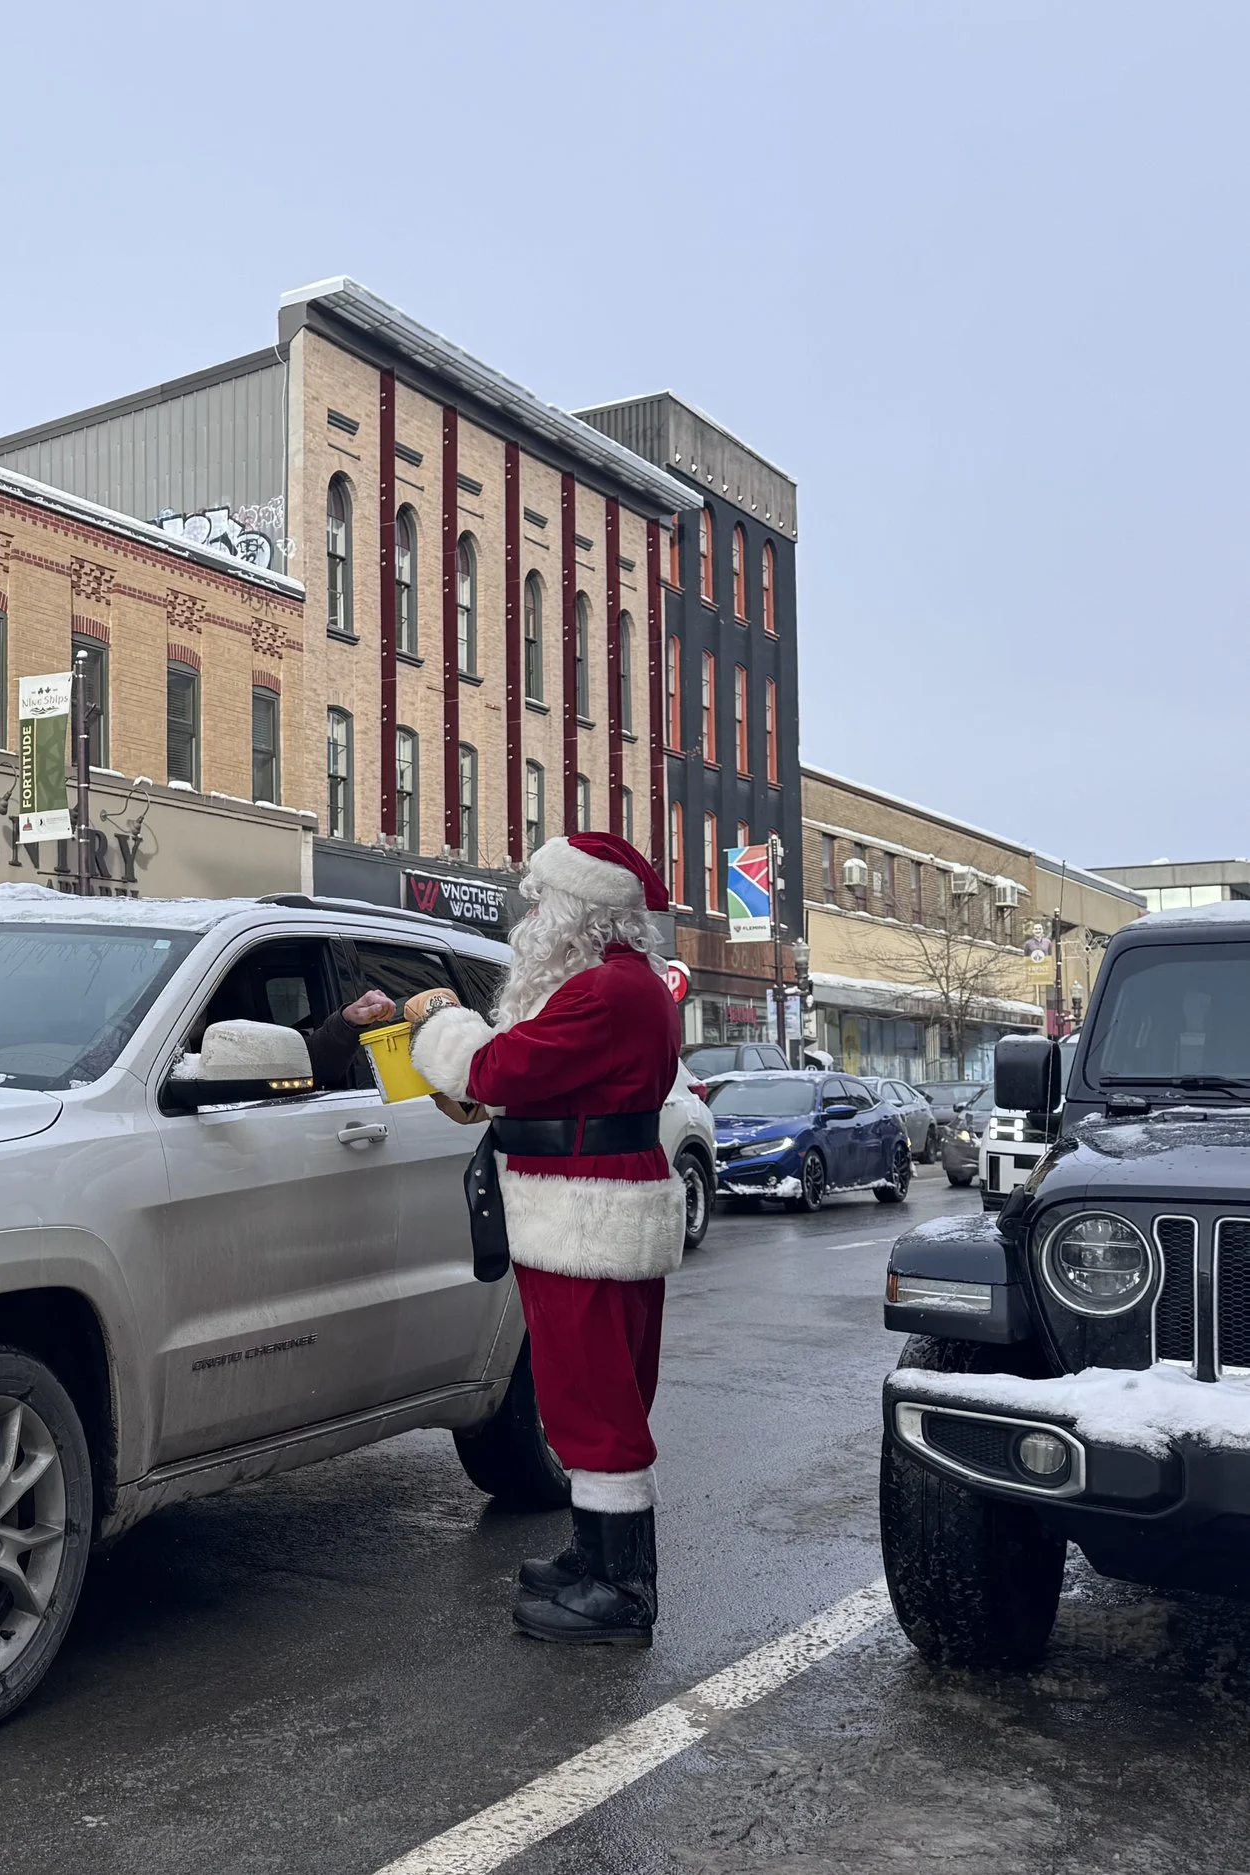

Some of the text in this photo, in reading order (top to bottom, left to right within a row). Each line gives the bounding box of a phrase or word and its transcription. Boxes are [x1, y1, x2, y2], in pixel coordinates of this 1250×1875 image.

[44, 695, 69, 705] Ships
[22, 725, 32, 808] FORTITUDE
[440, 882, 504, 905] ANOTHER
[450, 900, 498, 922] WORLD
[192, 1332, 318, 1371] GRAND CHEROKEE
